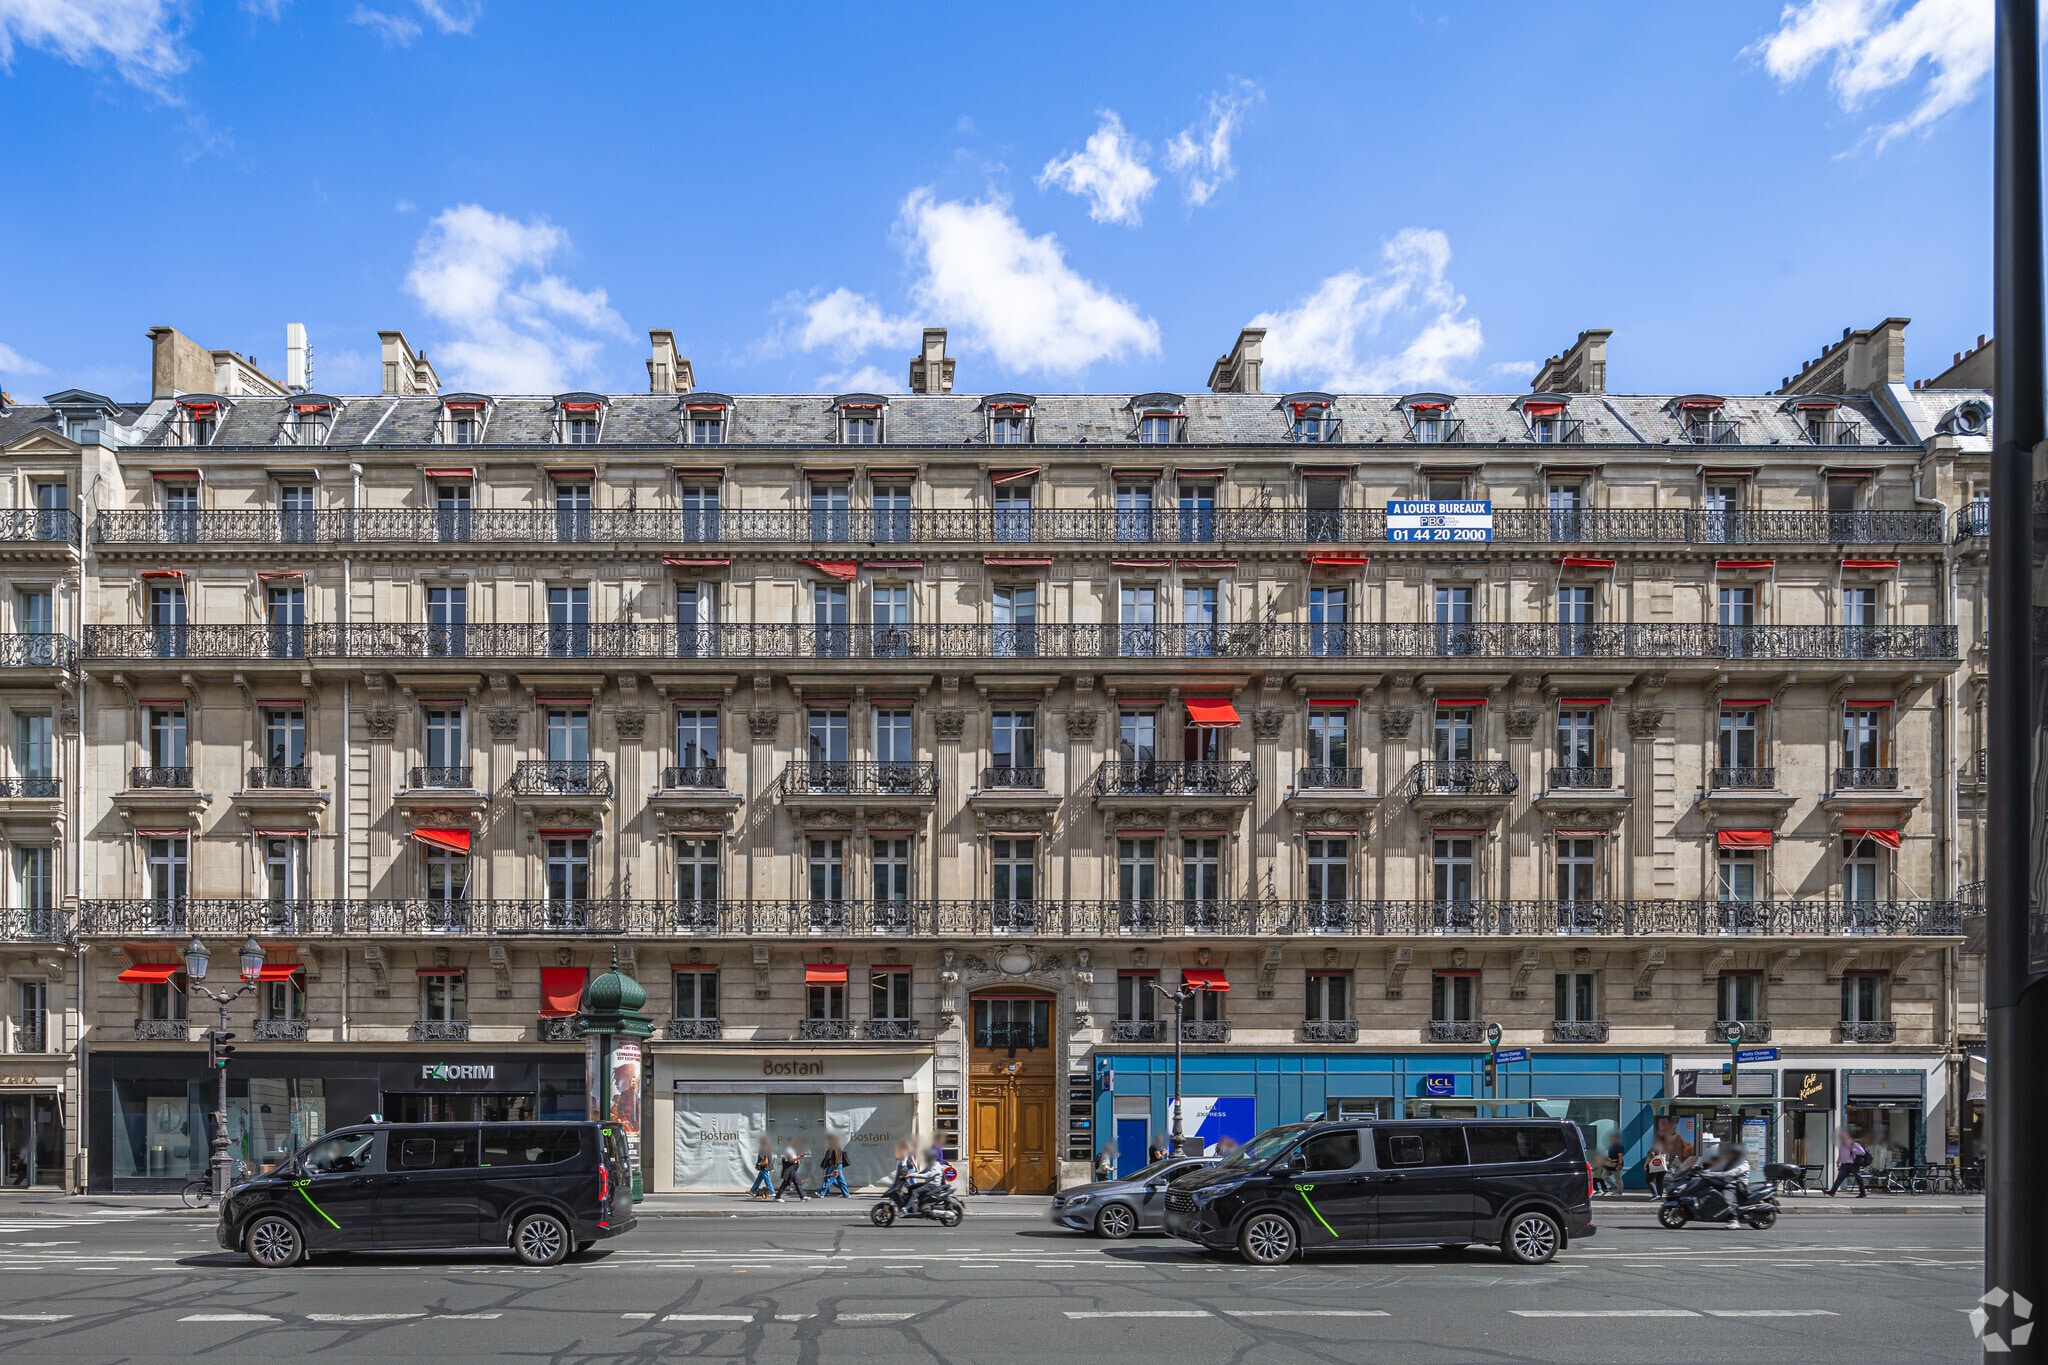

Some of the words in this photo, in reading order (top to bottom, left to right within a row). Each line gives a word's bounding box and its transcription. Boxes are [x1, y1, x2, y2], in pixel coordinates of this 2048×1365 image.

[1393, 503, 1401, 514] A
[1403, 503, 1436, 514] LOUER
[1439, 503, 1486, 514] BUREAUX
[1393, 529, 1408, 541] 01
[1413, 529, 1430, 541] 44
[1433, 529, 1450, 541] 20
[1453, 529, 1486, 541] 2000
[1488, 1027, 1498, 1036] BUS
[1728, 1026, 1740, 1035] BUS
[763, 1059, 824, 1075] Bostani
[1429, 1078, 1452, 1086] LCL
[700, 1130, 740, 1141] Bostani
[850, 1131, 890, 1142] Bostani
[300, 1179, 312, 1187] G7
[1303, 1184, 1315, 1192] G7
